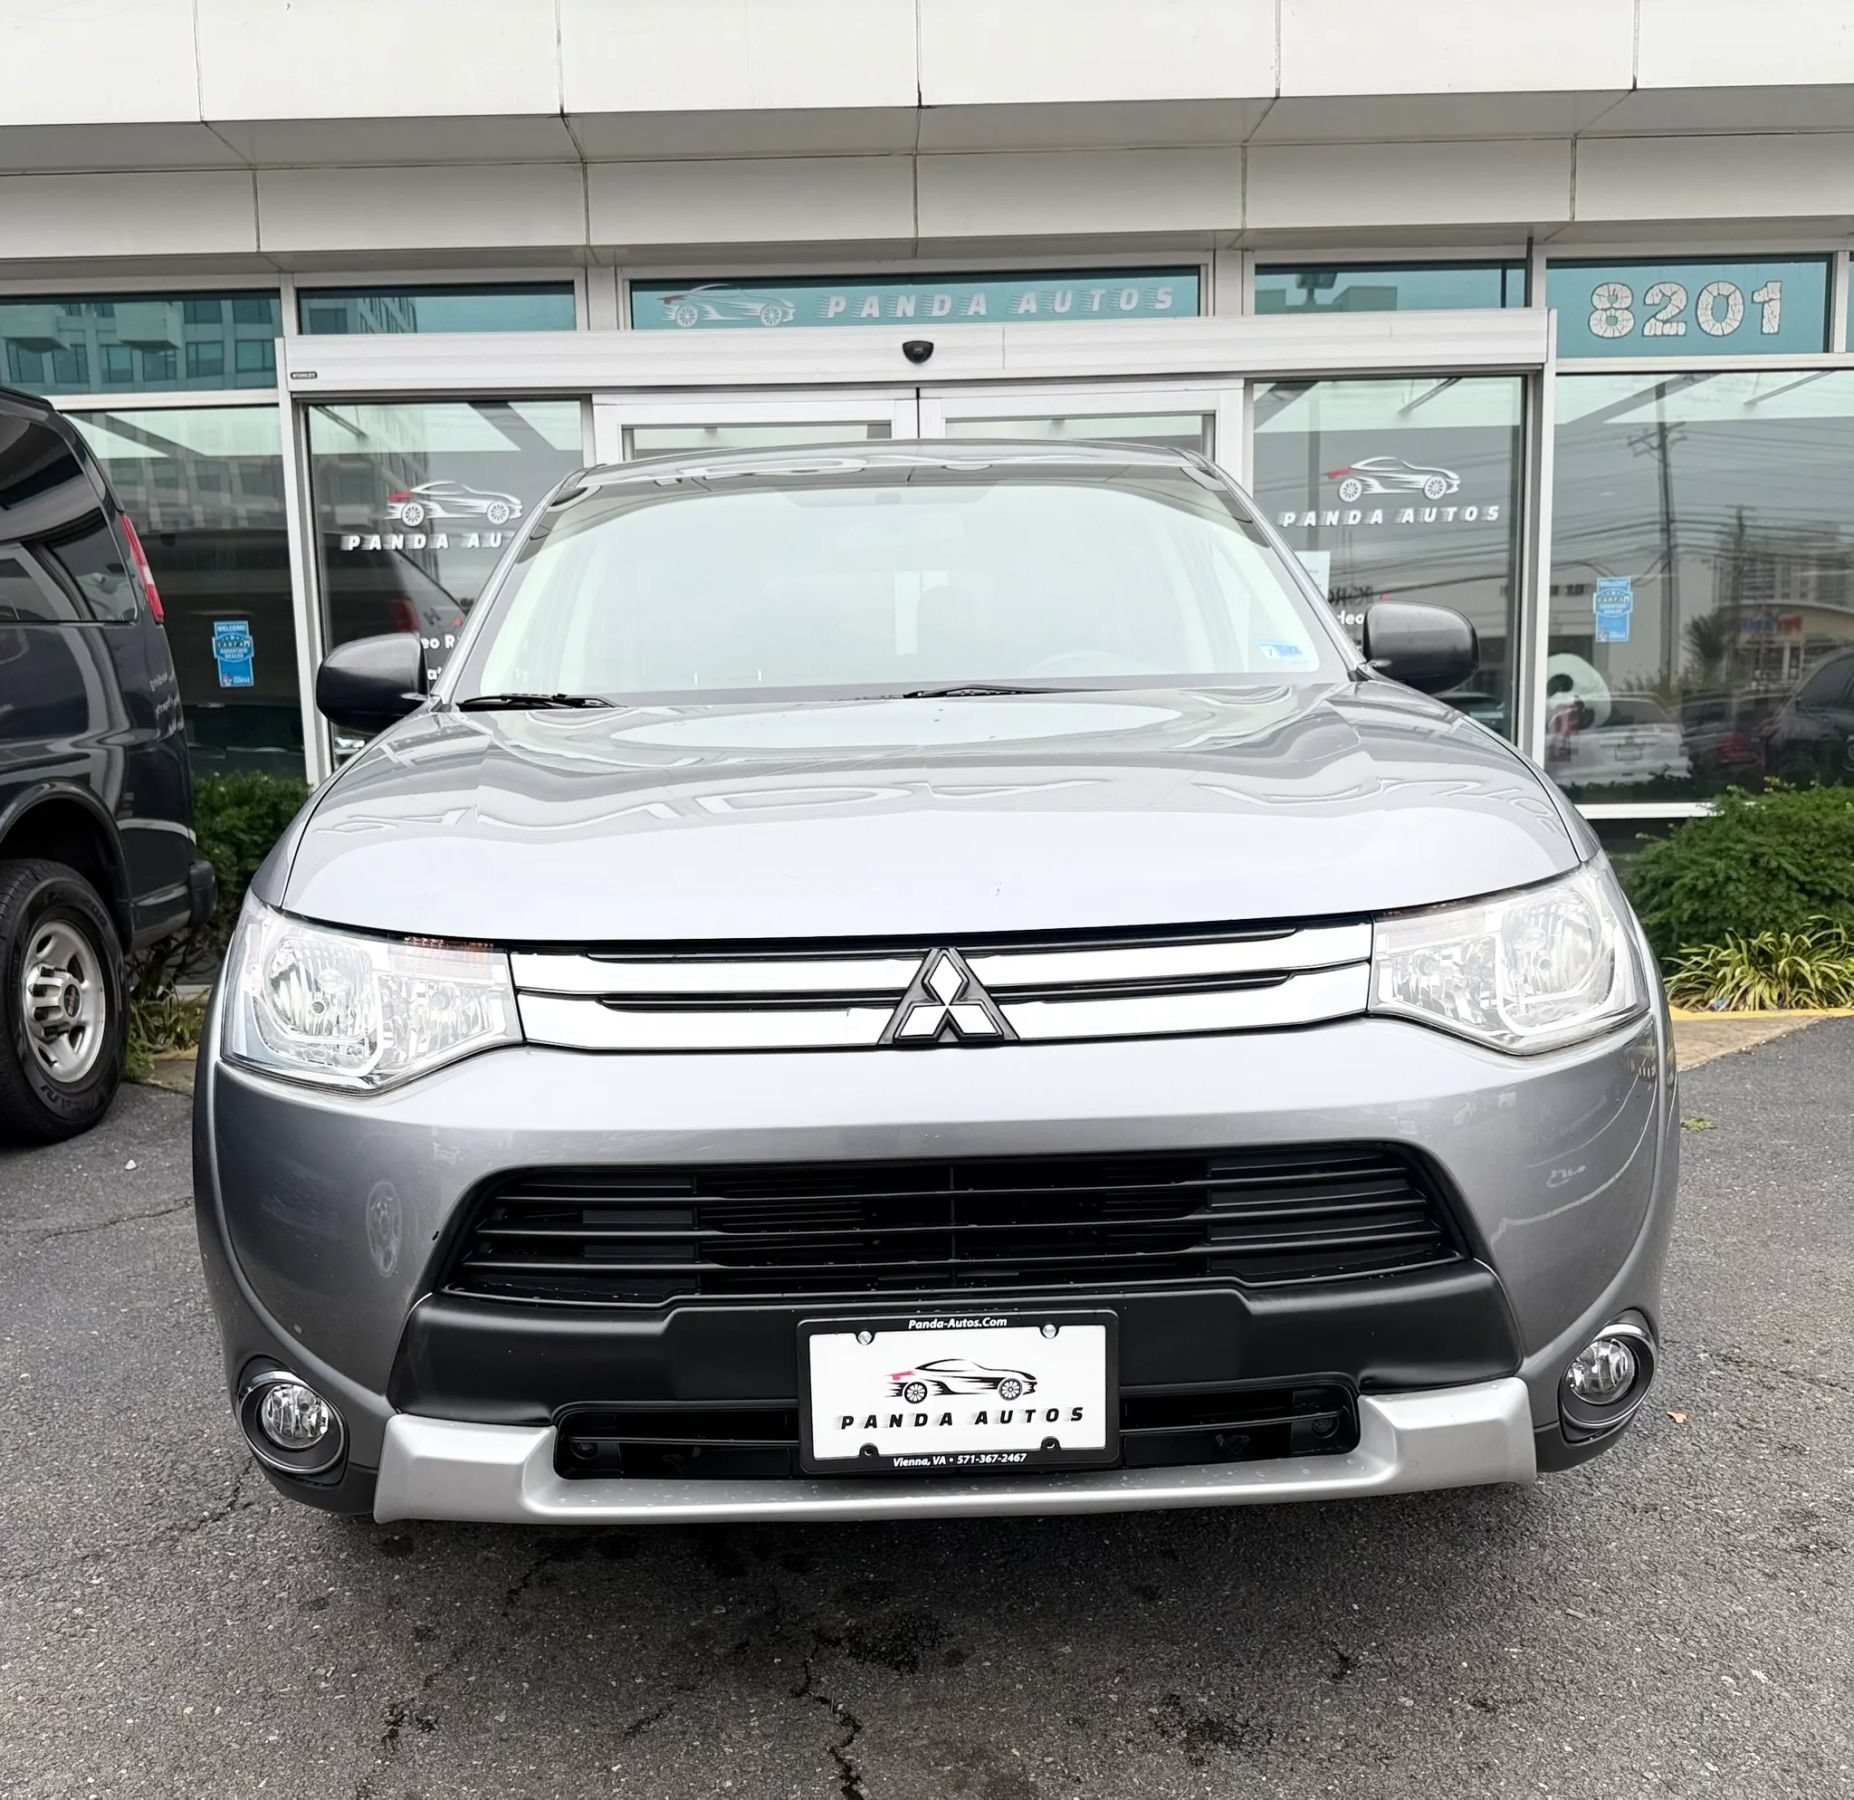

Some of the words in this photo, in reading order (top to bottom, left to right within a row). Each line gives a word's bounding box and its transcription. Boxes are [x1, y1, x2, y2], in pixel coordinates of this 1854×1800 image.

[826, 293, 987, 319] PANDA
[1016, 287, 1174, 314] AUTOS
[1588, 280, 1783, 338] 8201
[1281, 509, 1384, 527] PANDA
[1400, 506, 1500, 524] AUTOS
[347, 533, 449, 550] PANDA
[466, 532, 503, 548] AU
[908, 1317, 1008, 1330] Panda-Autos.Com
[841, 1412, 953, 1430] PANDA
[974, 1406, 1083, 1425] AUTOS
[893, 1456, 931, 1467] Vienna,
[932, 1455, 947, 1466] VA
[956, 1452, 1028, 1465] 571-367-2467
